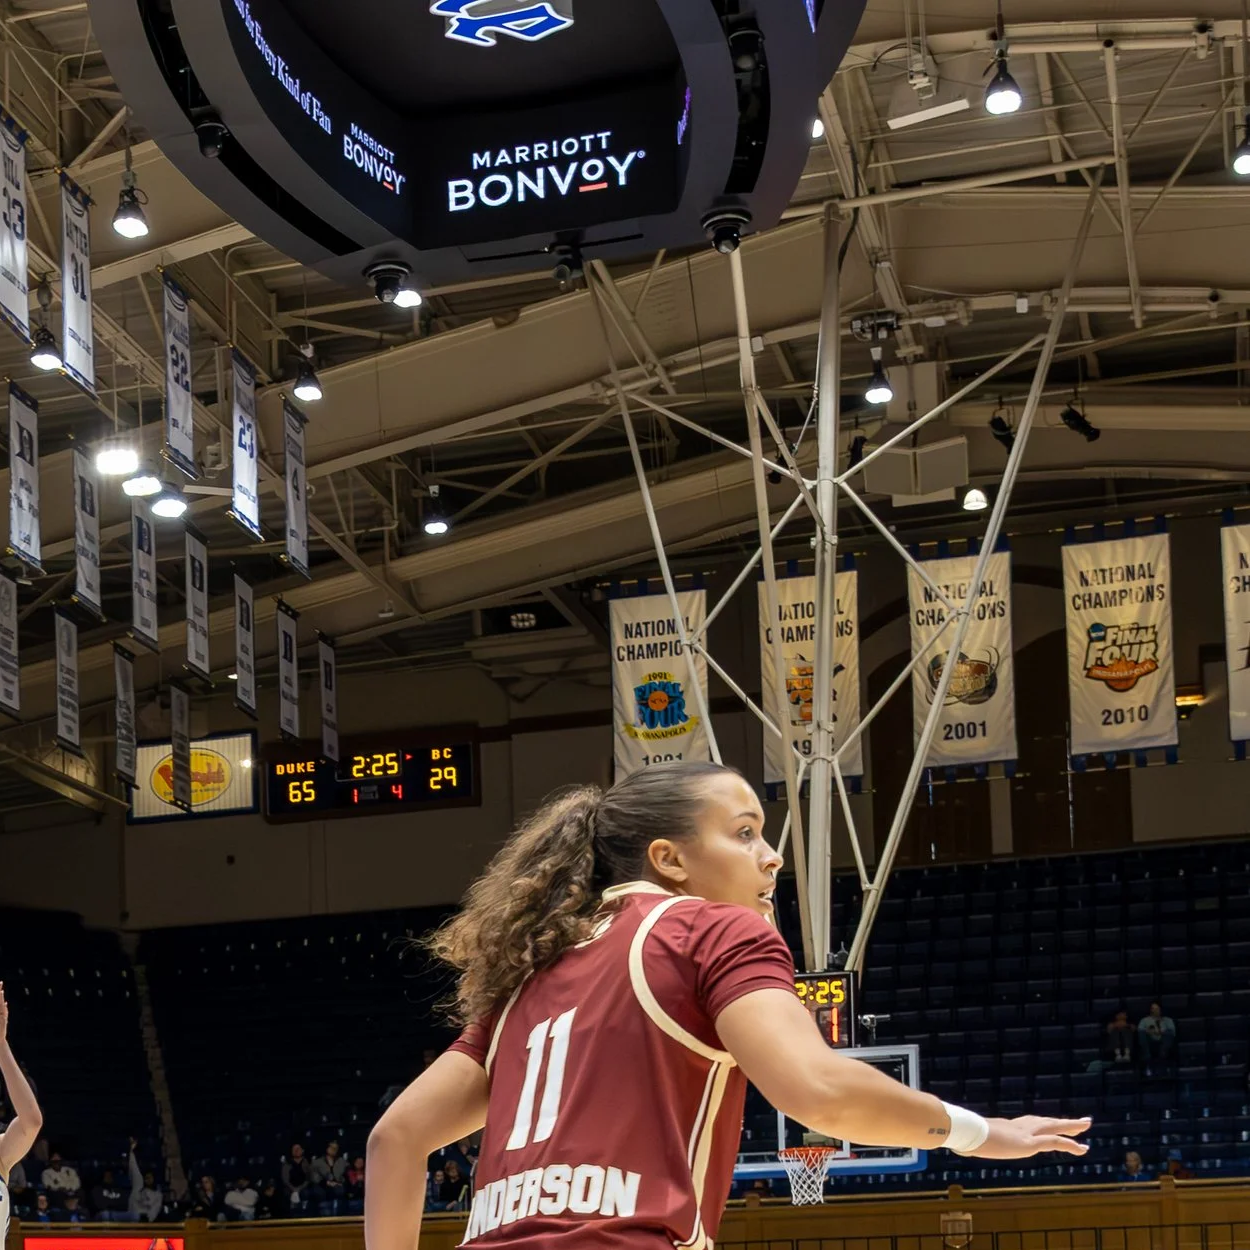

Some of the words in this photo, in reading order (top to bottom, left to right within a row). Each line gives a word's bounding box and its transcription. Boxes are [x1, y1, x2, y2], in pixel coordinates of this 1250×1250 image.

[254, 20, 277, 76] Every
[277, 55, 300, 103] Kind
[301, 91, 311, 115] of
[312, 97, 332, 135] Fan
[351, 122, 395, 164] MARRIOTT
[472, 131, 611, 170] MARRIOTT
[343, 134, 402, 195] BONVOY
[447, 151, 638, 212] BONVOY
[238, 414, 254, 459] 23
[1079, 562, 1155, 587] NATIONAL
[924, 580, 997, 604] NATIOAL
[1072, 584, 1165, 611] CHAMPIONS
[624, 616, 694, 640] NATIONL
[1106, 625, 1157, 646] FINAL
[1084, 641, 1159, 671] FOUR
[634, 681, 684, 699] FINAL
[1101, 704, 1149, 727] 2010
[943, 720, 988, 741] 2001
[276, 761, 315, 775] DUKE
[352, 752, 399, 778] 2:25
[429, 766, 457, 790] 29
[288, 780, 316, 803] 65
[391, 784, 403, 799] 4
[506, 1006, 578, 1151] 11
